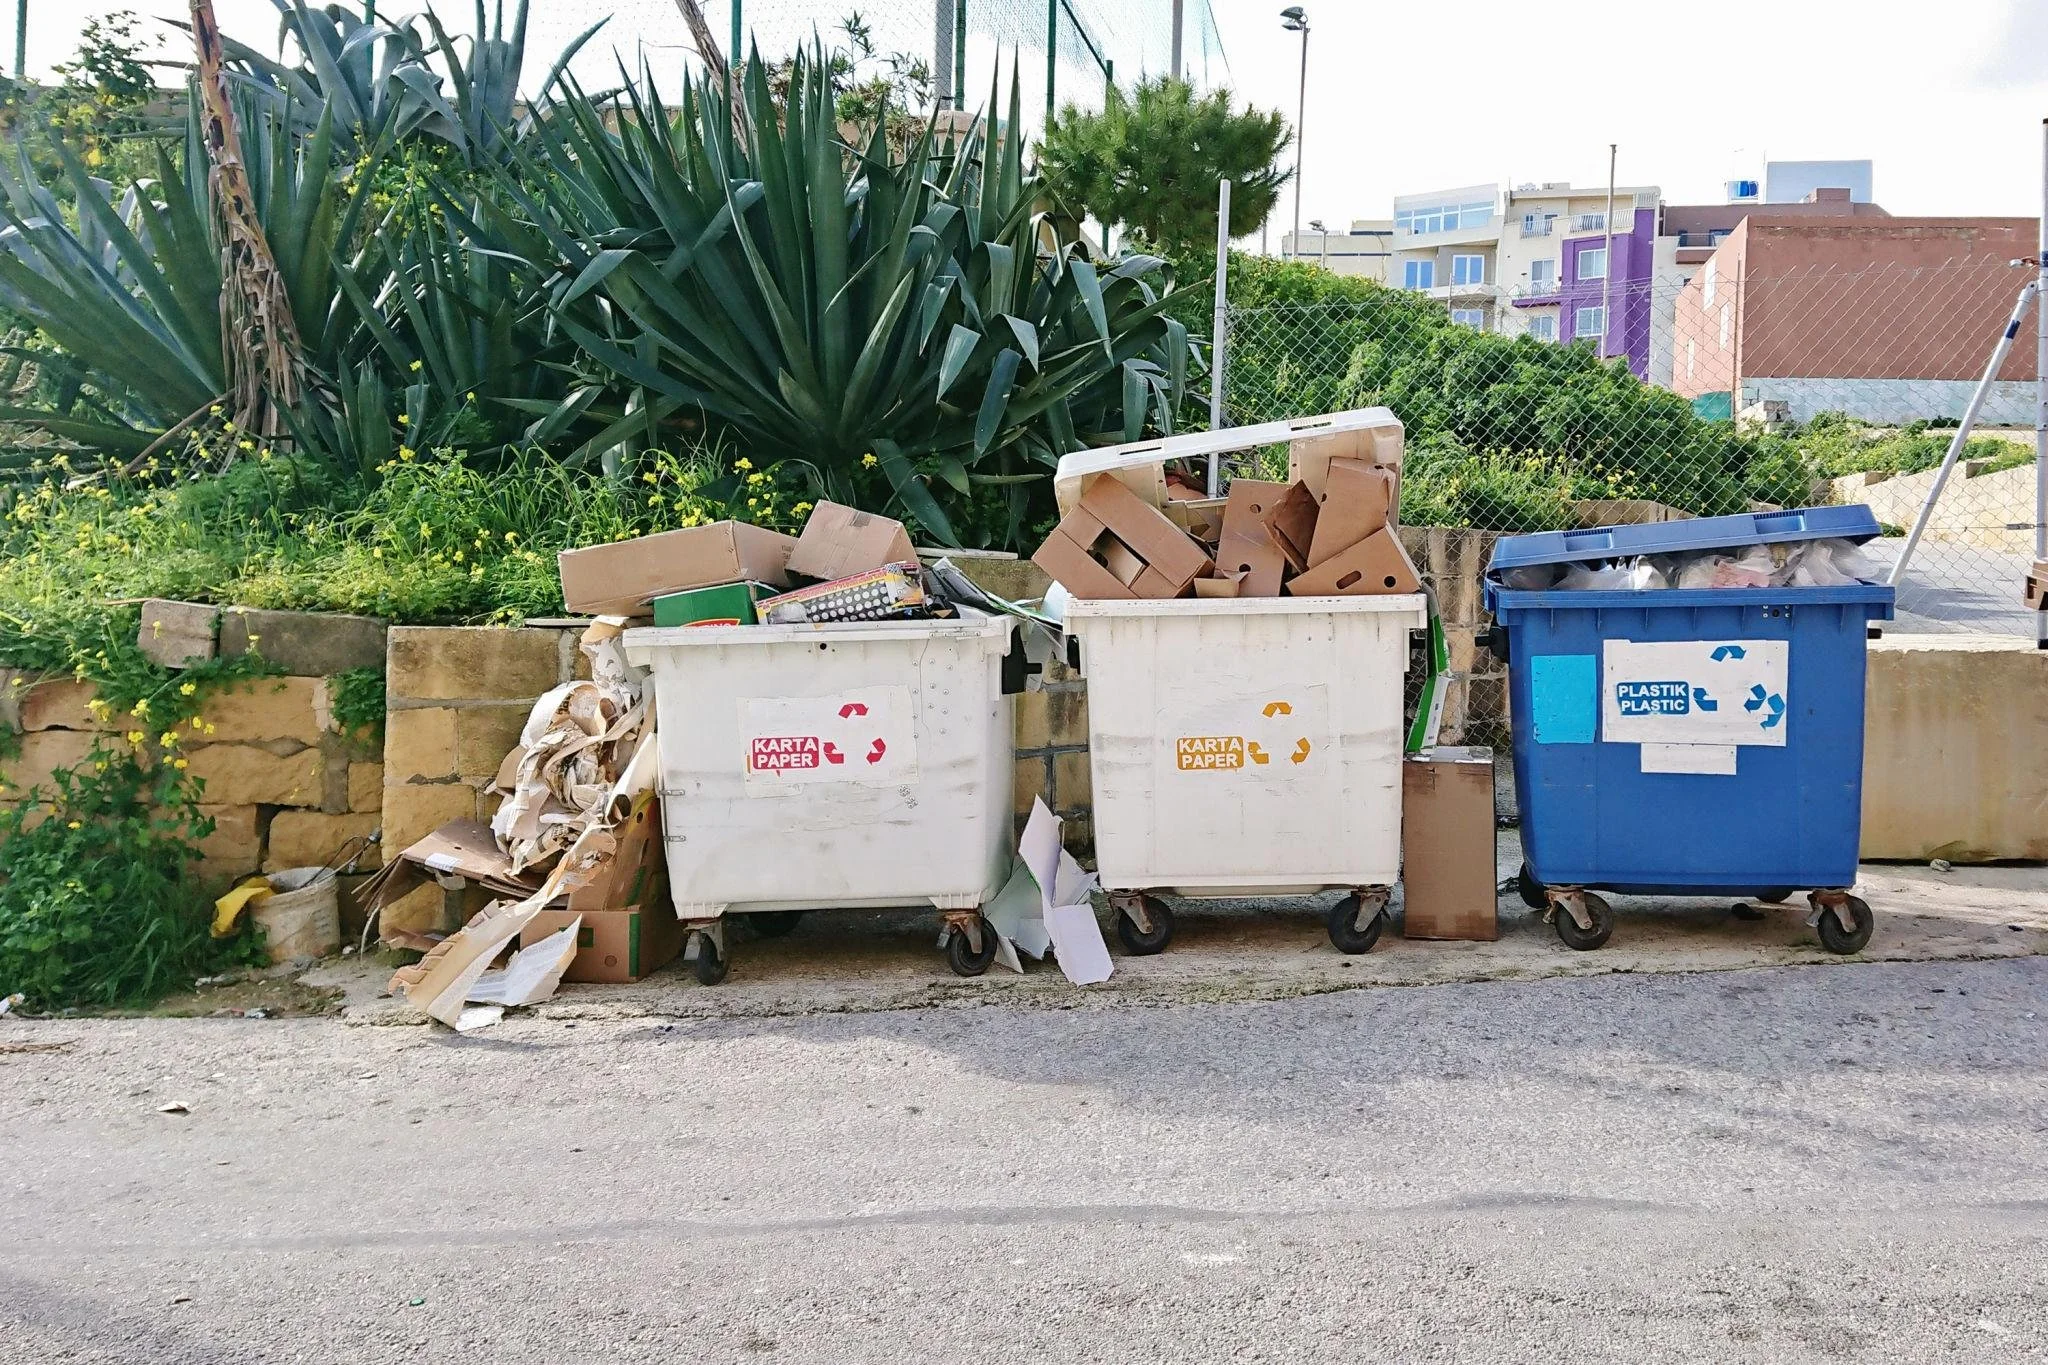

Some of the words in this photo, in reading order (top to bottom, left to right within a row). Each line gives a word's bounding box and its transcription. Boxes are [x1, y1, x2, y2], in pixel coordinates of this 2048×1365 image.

[1618, 684, 1687, 698] PLASTIK
[1621, 699, 1685, 712] PLASTIC
[754, 738, 818, 753] KARTA
[1179, 737, 1242, 753] KARTA
[757, 753, 813, 768] PAPER
[1182, 753, 1238, 768] PAPER
